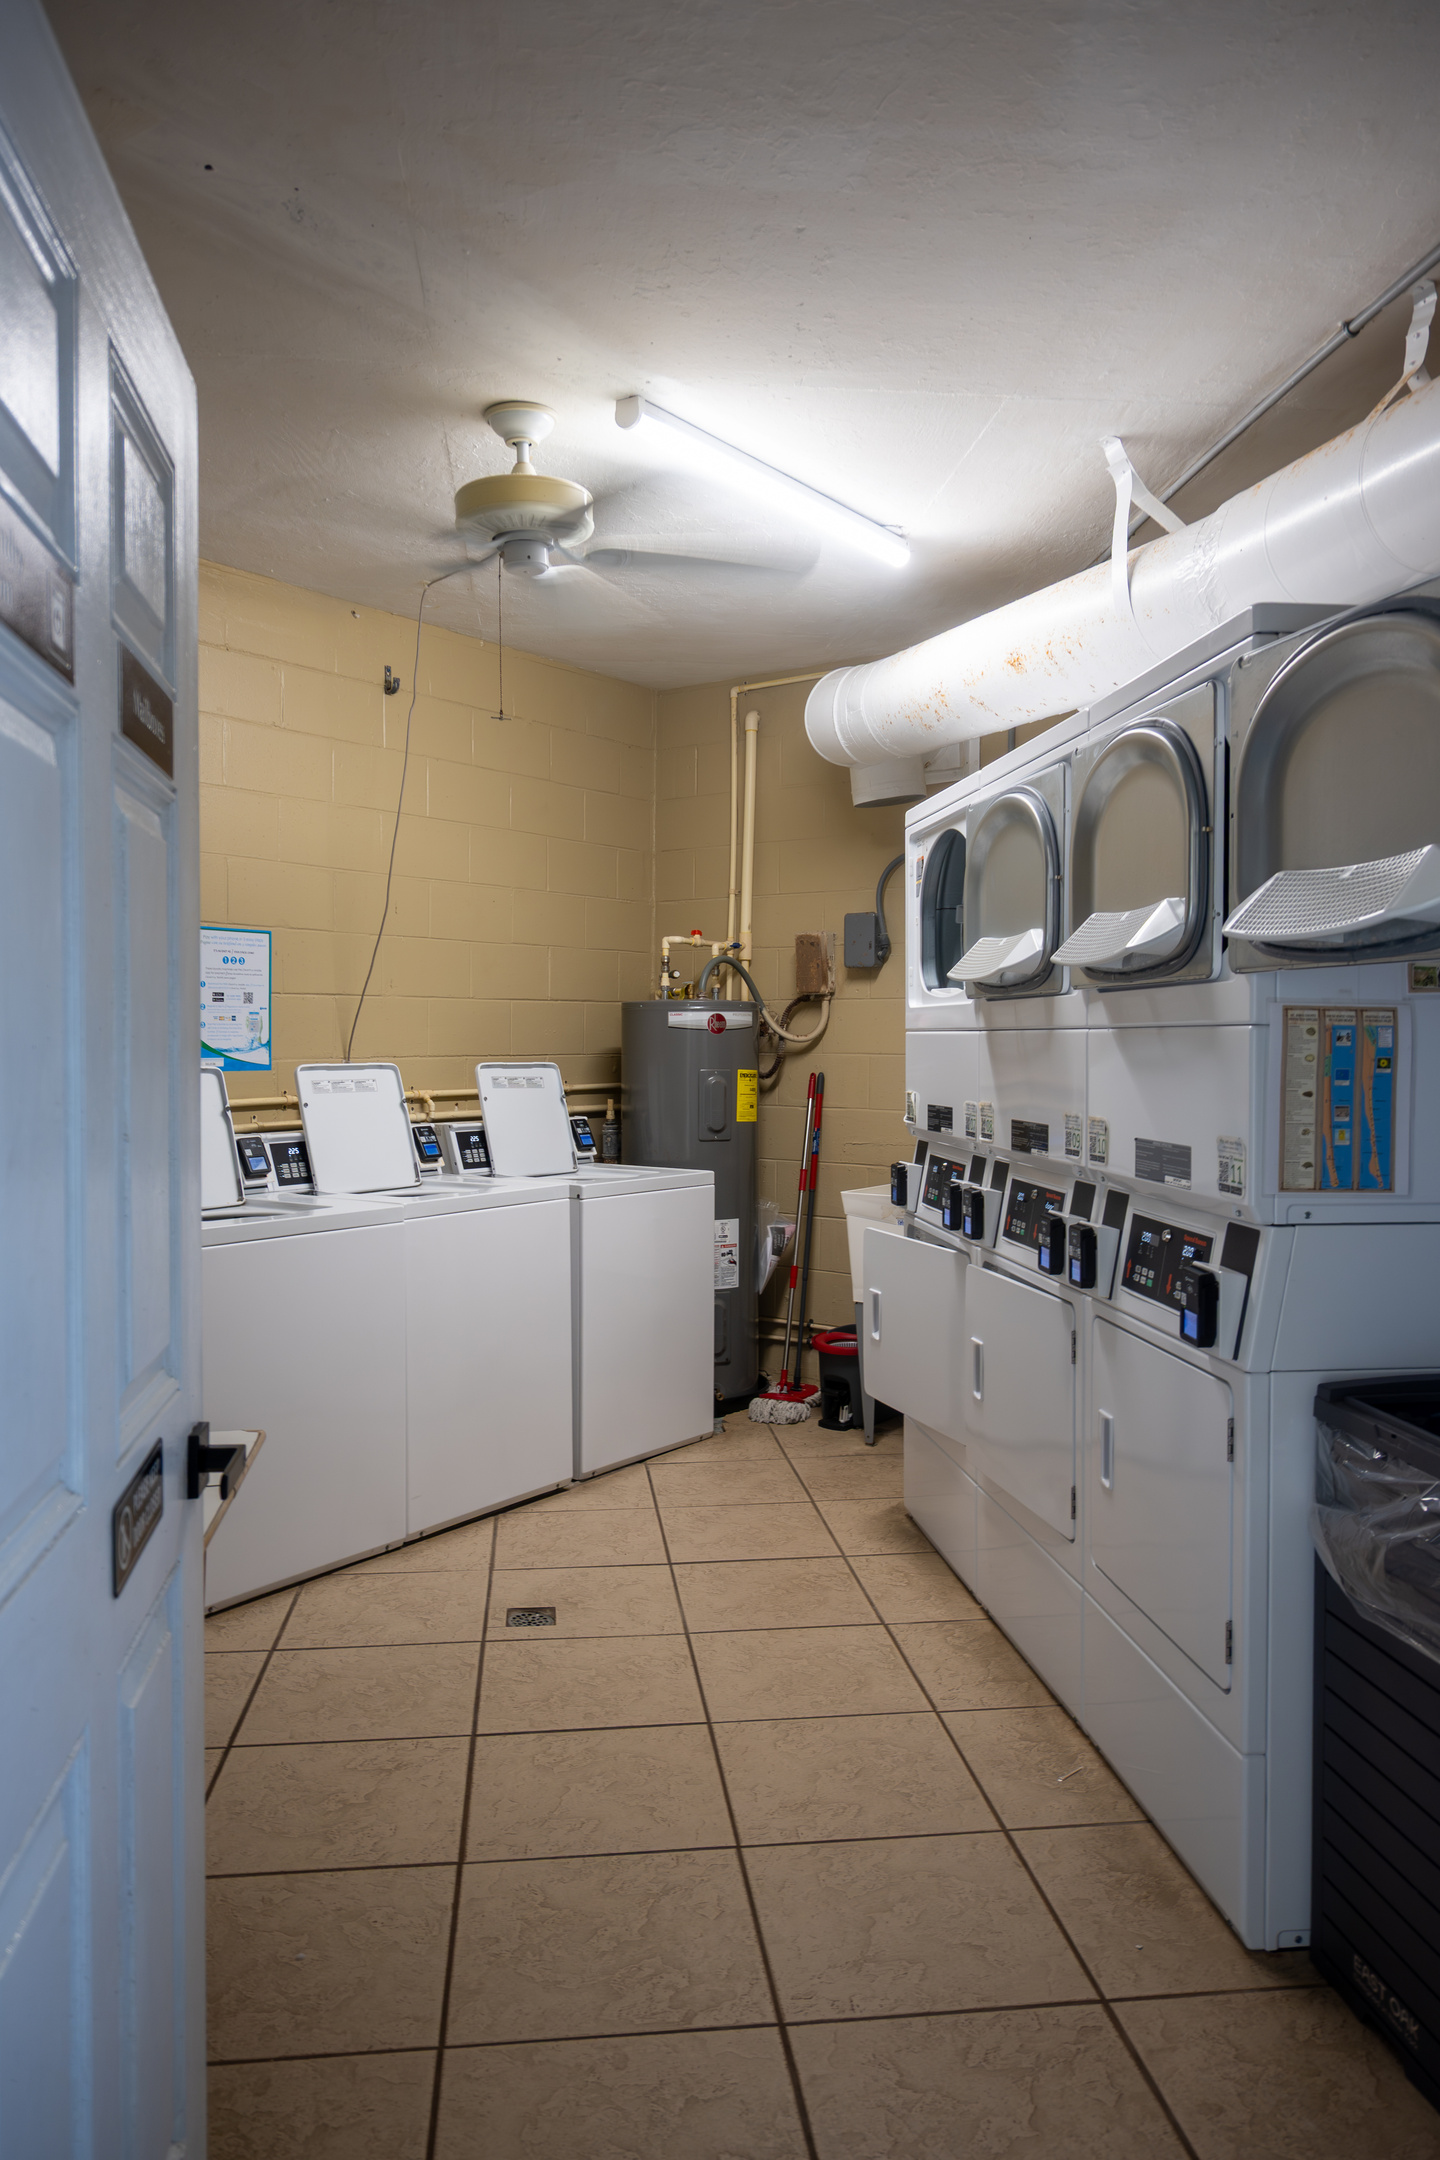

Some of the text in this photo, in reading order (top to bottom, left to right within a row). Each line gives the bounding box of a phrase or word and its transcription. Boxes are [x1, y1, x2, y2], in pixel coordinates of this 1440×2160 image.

[710, 1013, 726, 1031] Rheem
[1072, 1133, 1080, 1149] 09
[1231, 1164, 1243, 1185] 11
[1353, 1954, 1386, 2001] EAST
[1389, 1996, 1420, 2040] OAK
